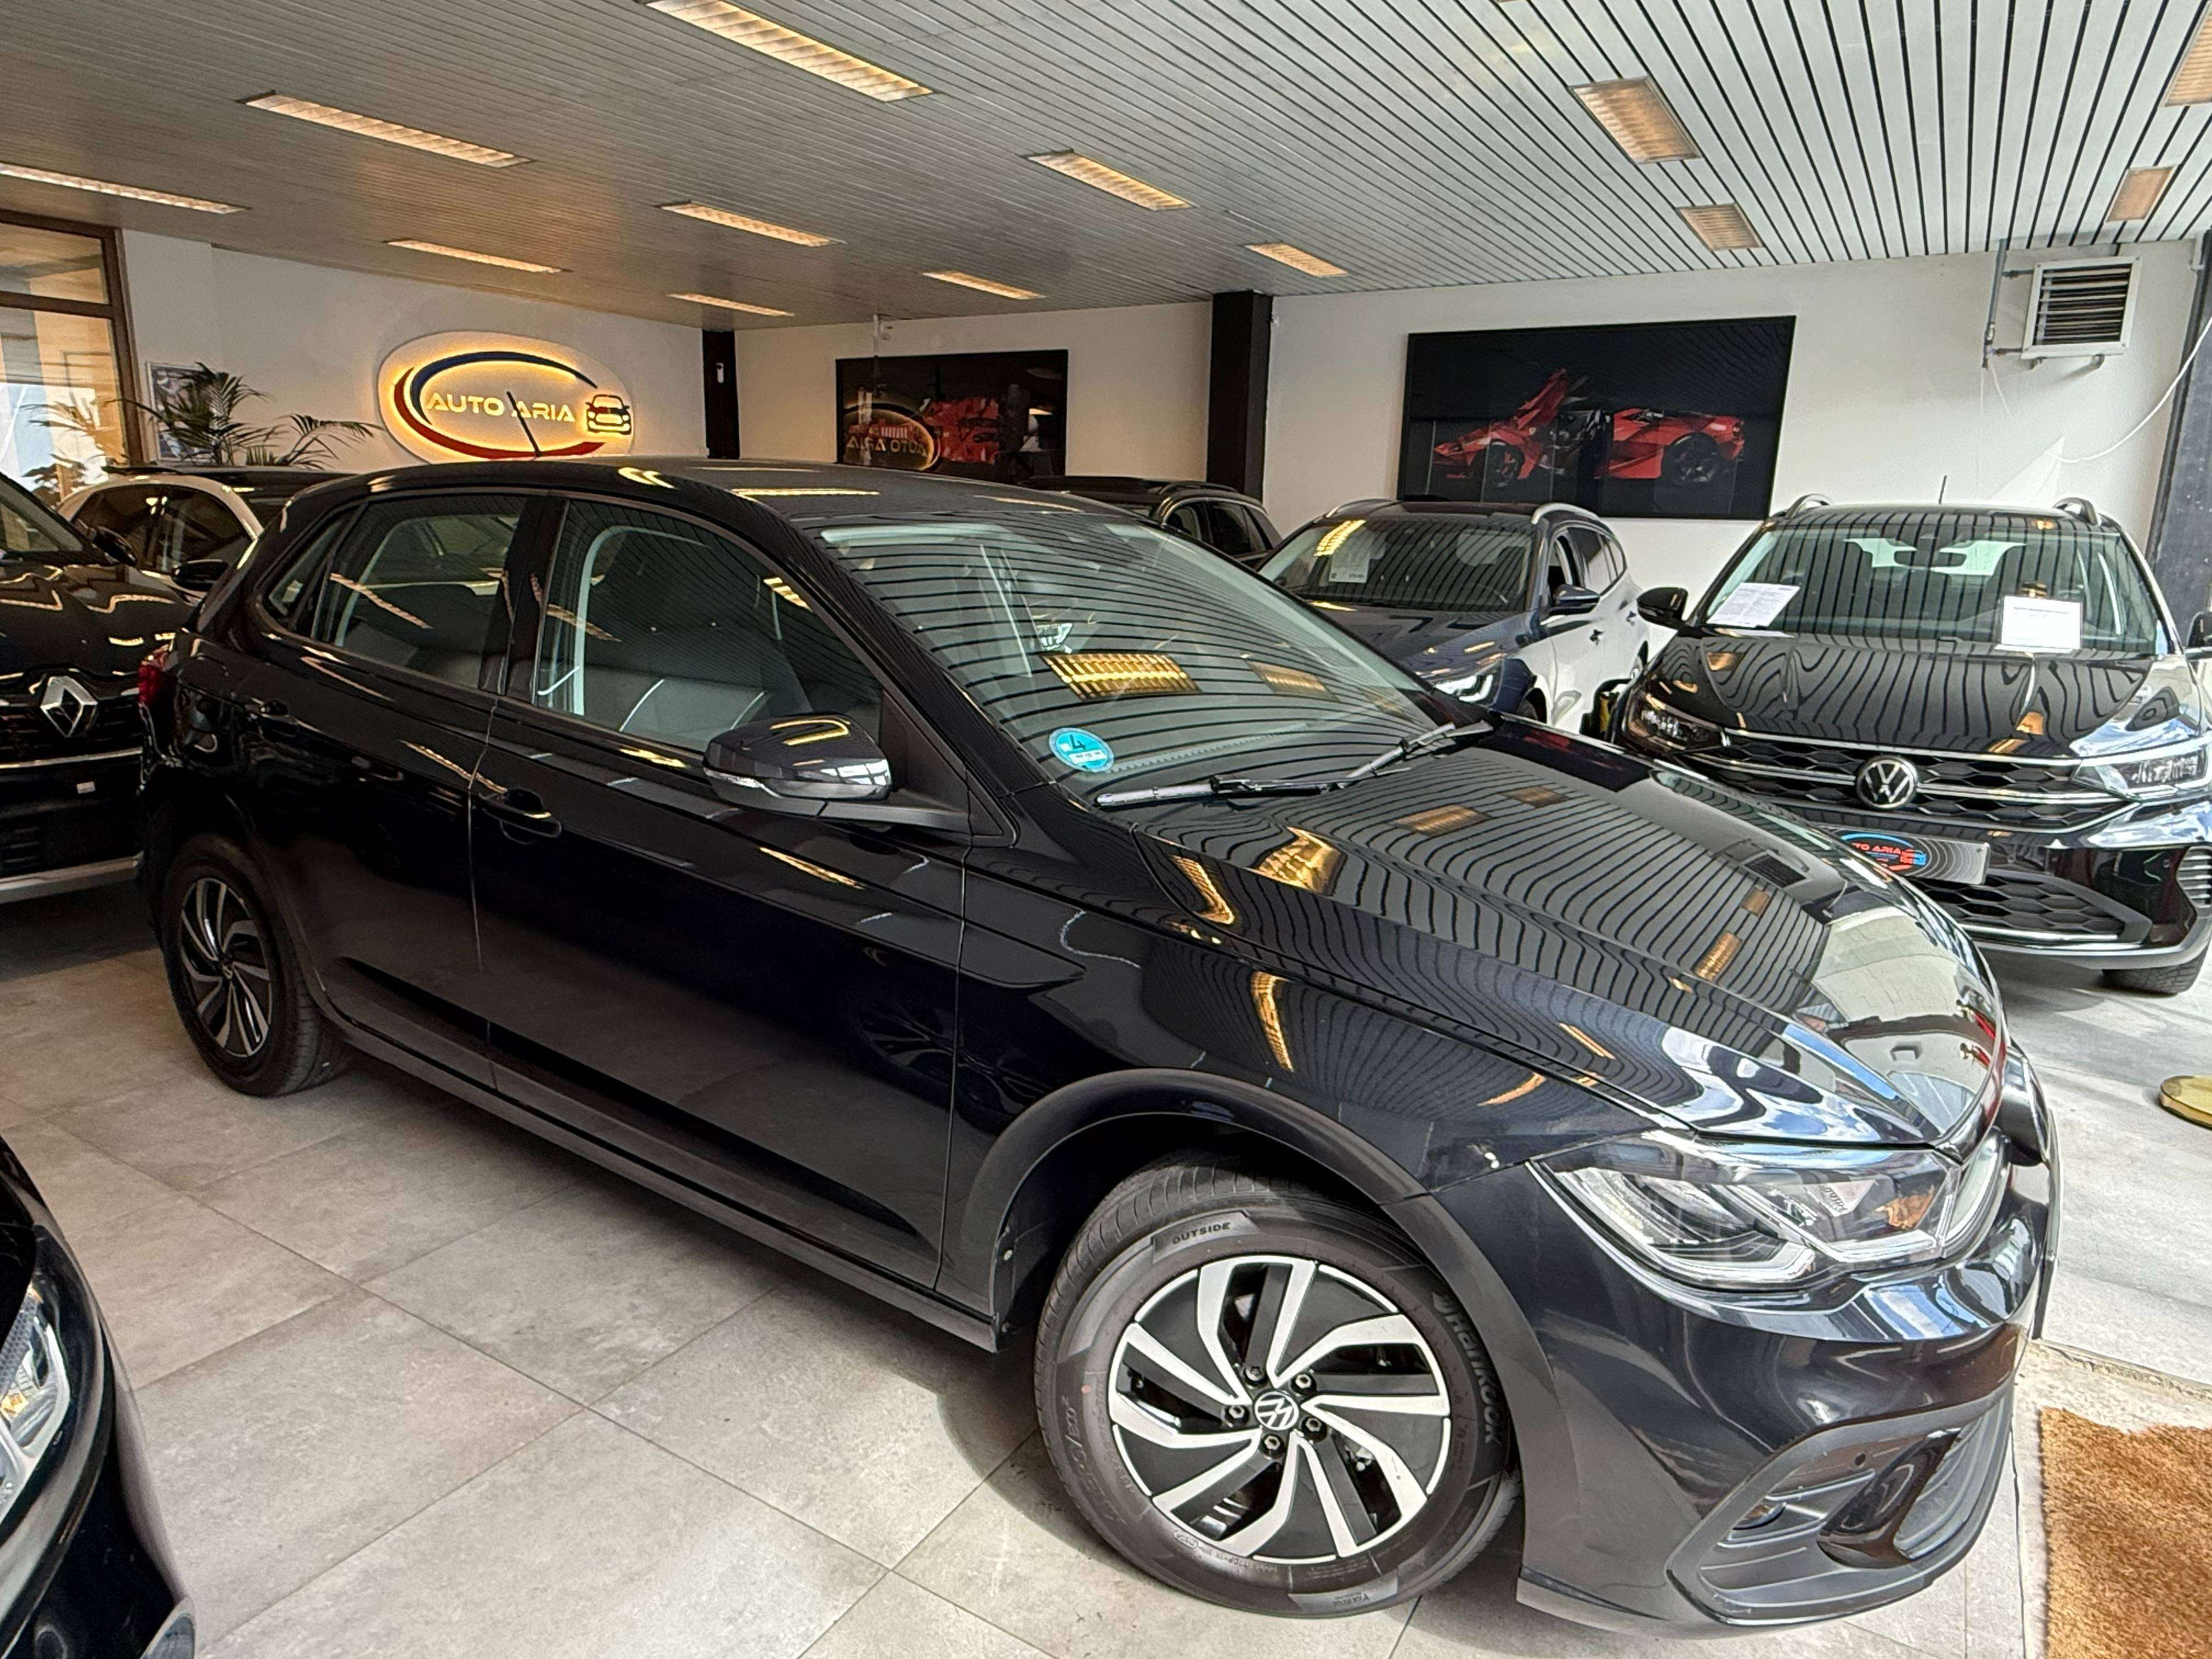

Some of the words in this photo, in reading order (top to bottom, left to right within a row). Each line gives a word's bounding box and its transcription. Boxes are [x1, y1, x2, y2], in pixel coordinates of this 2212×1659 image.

[425, 392, 505, 416] AUTO
[511, 400, 575, 422] ARIA
[1172, 1222, 1231, 1244] OUTSIDE
